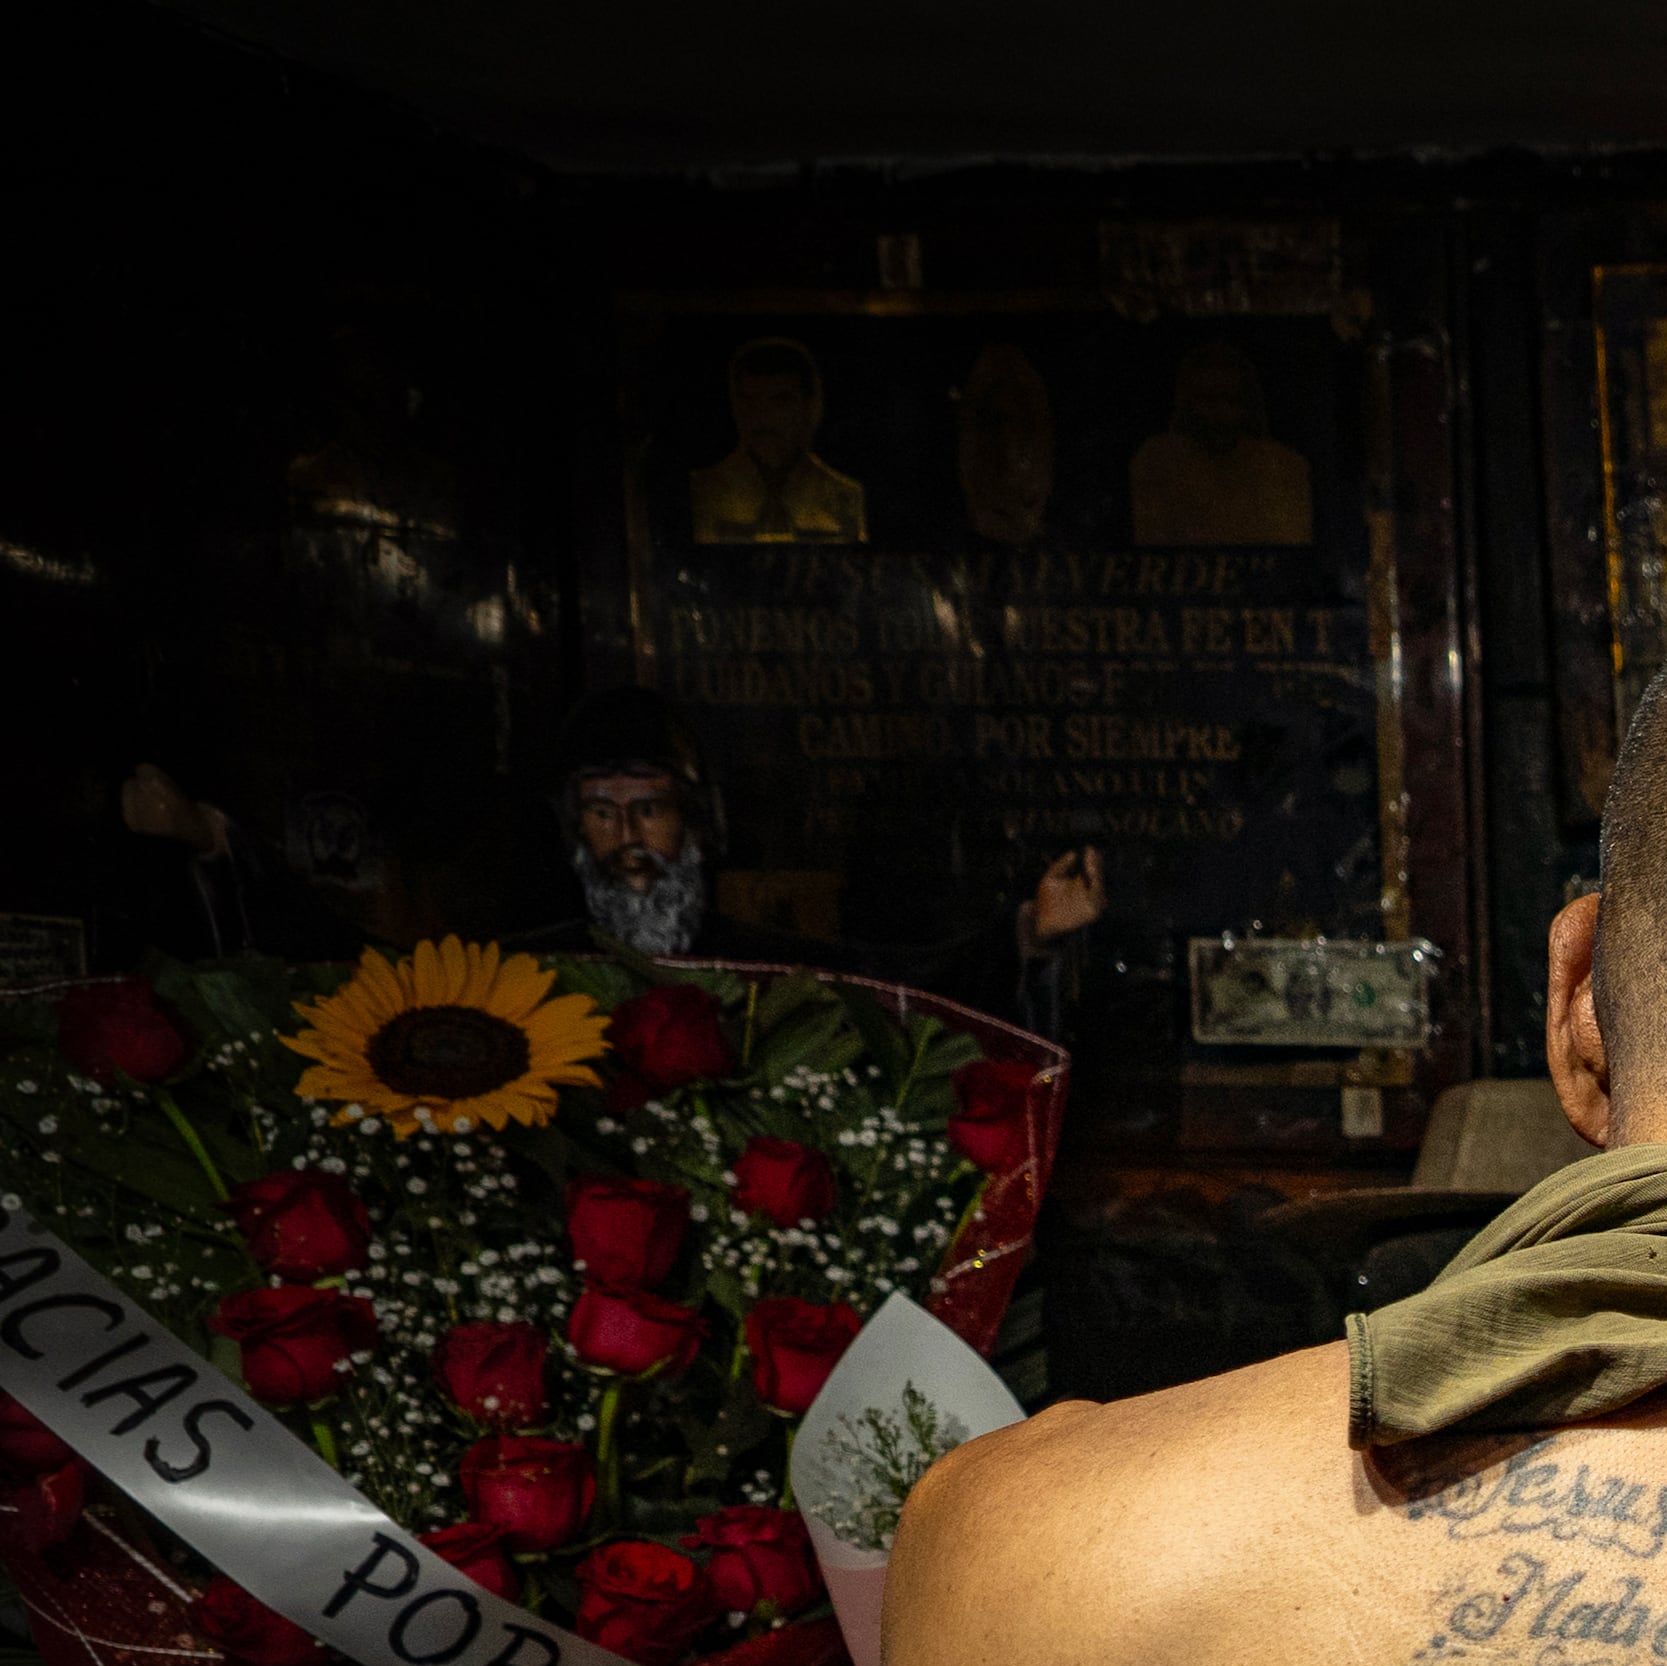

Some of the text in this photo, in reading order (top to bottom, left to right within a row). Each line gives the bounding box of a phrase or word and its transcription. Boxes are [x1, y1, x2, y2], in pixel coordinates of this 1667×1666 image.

[997, 606, 1171, 655] UESTRA
[1181, 605, 1234, 655] FE
[1242, 605, 1296, 655] EN
[973, 714, 1053, 761] POR
[1064, 713, 1242, 762] SIEMPRE
[0, 1210, 253, 1484] ACIAS
